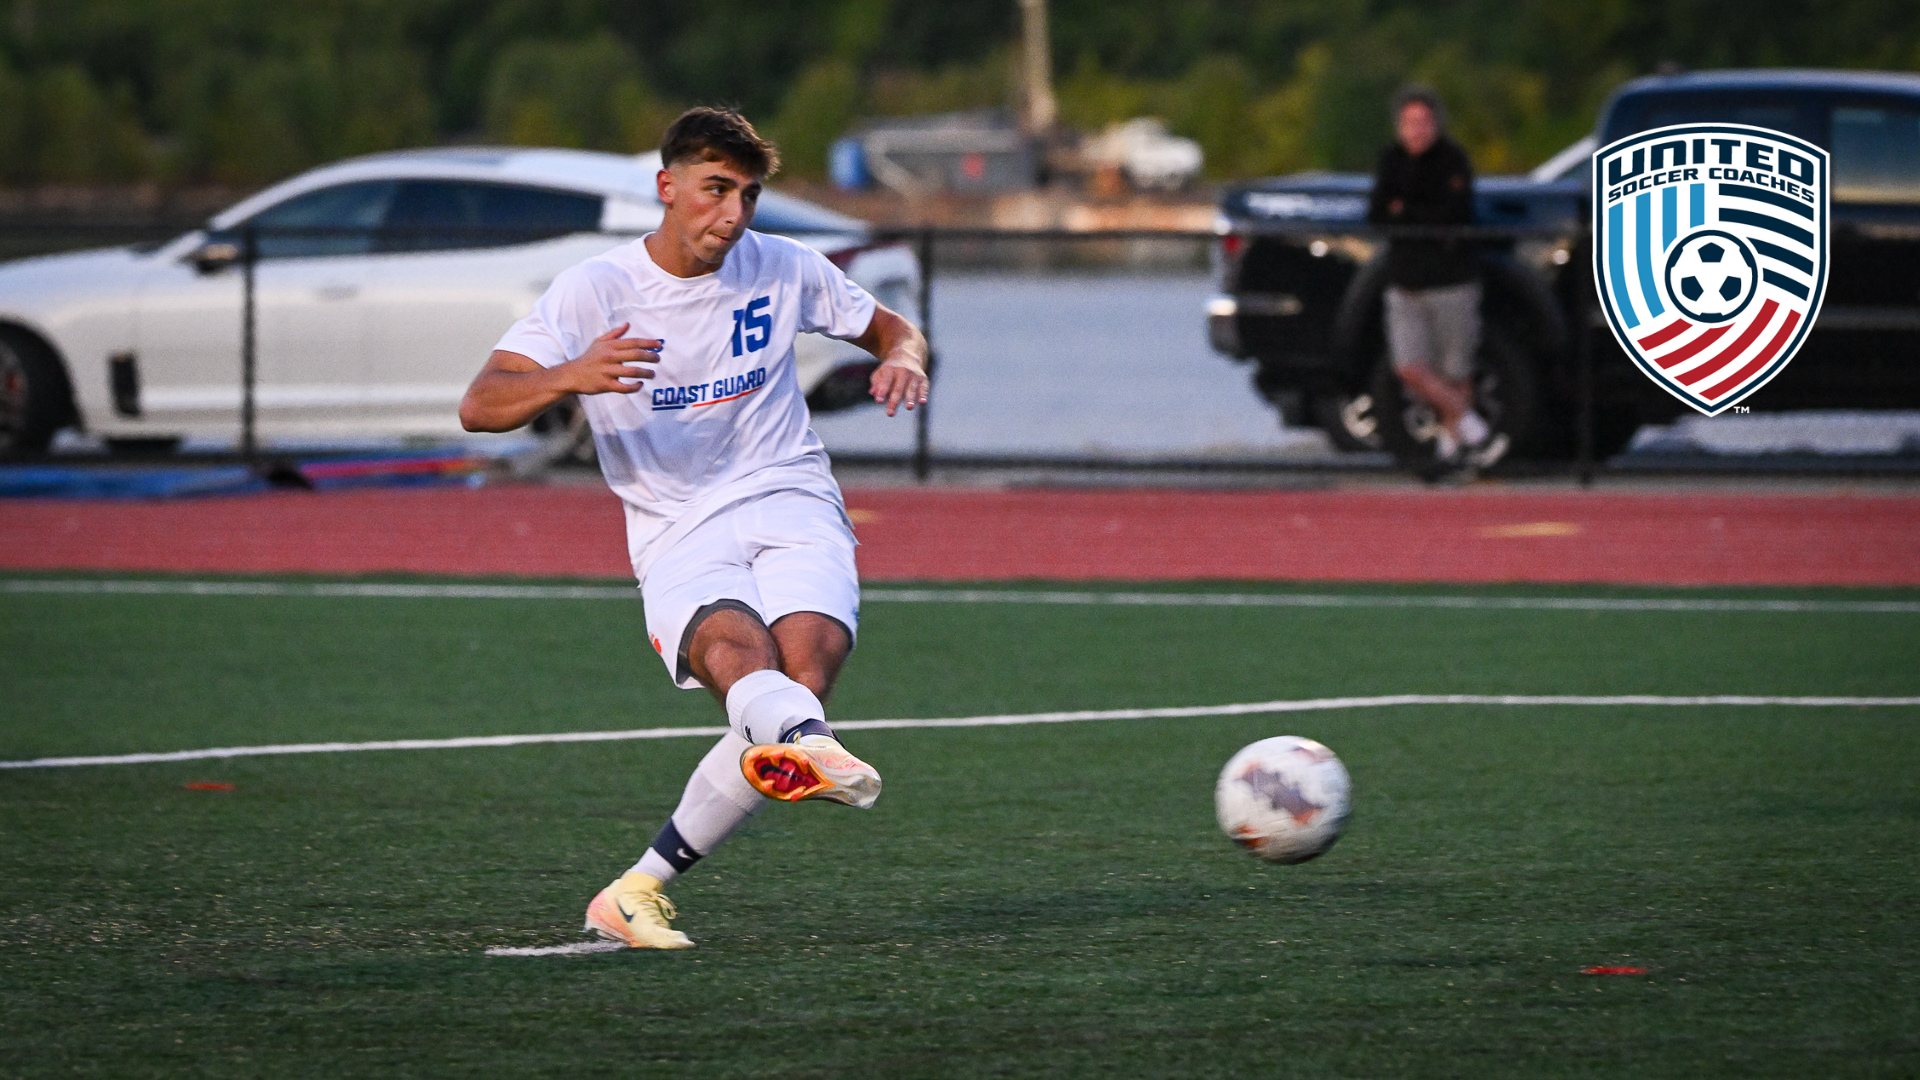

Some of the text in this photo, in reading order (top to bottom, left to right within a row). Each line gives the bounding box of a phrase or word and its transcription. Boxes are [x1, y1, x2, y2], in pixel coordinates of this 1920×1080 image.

[732, 296, 771, 357] 15
[652, 367, 766, 405] COAST GUARD
